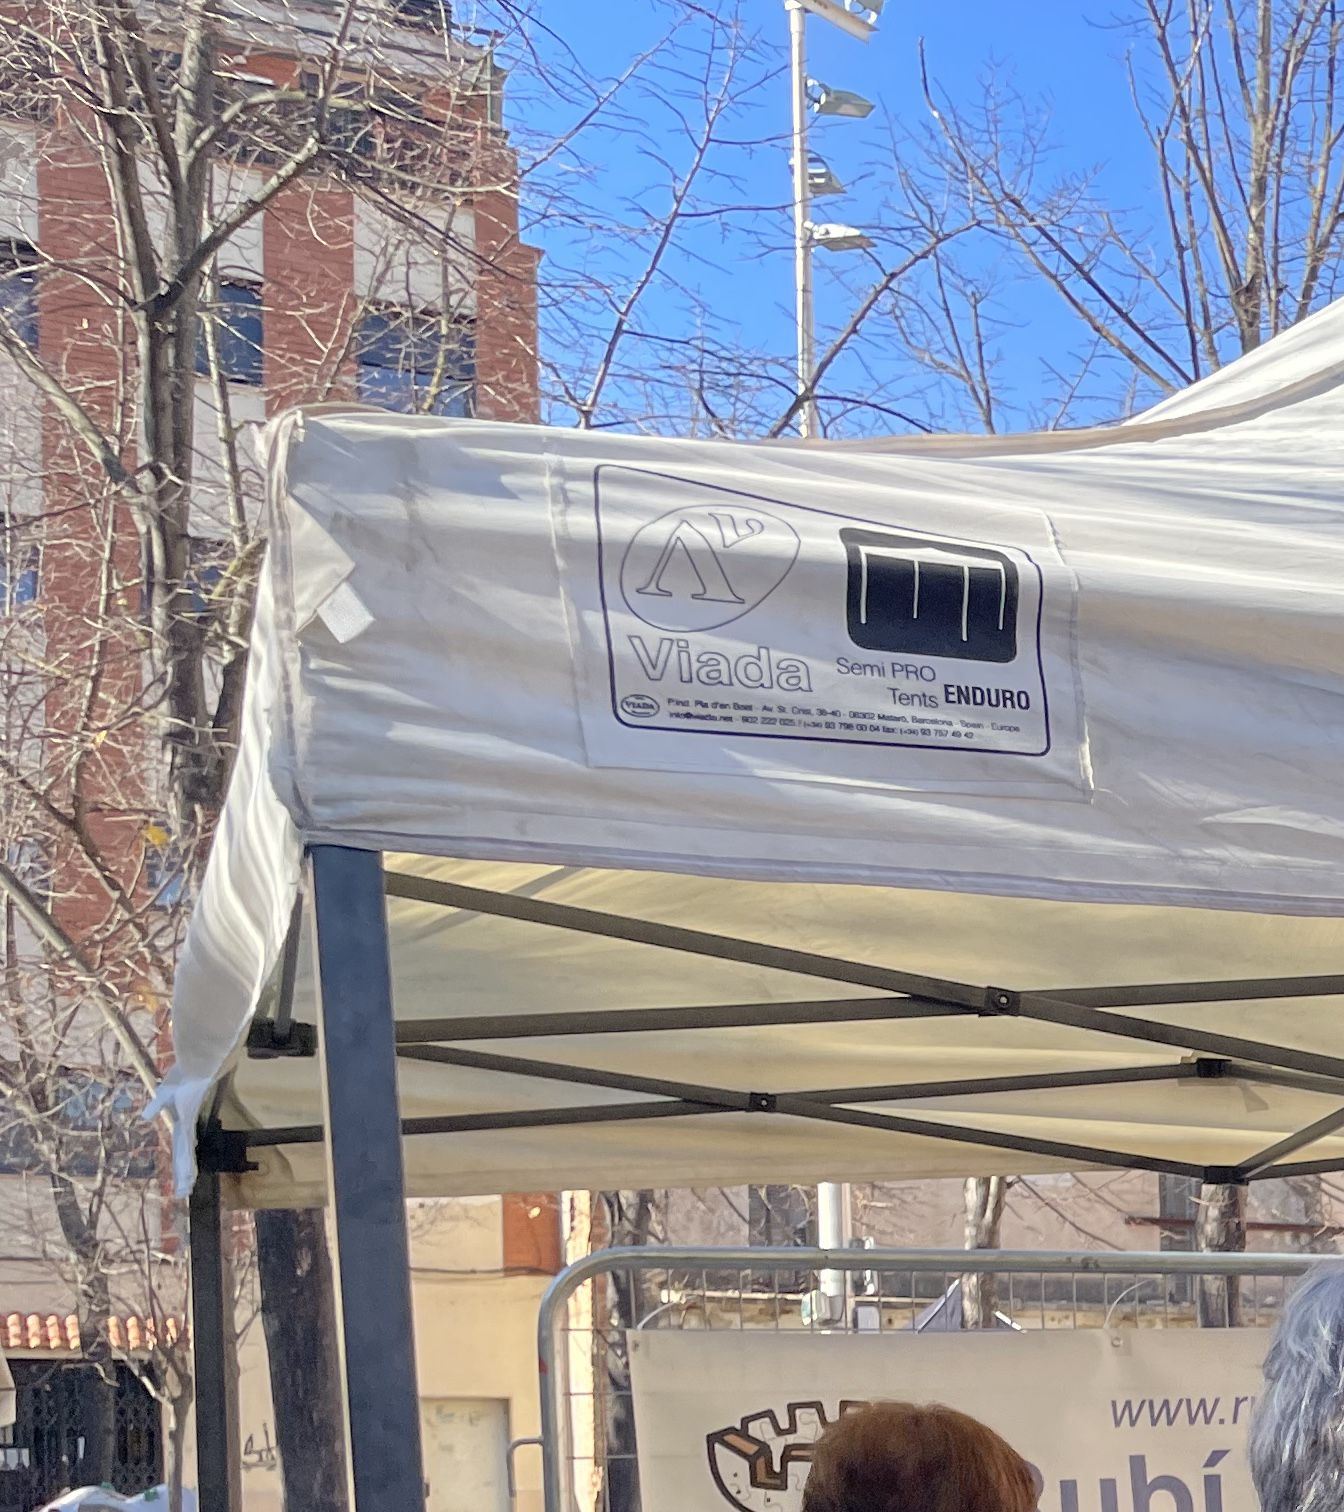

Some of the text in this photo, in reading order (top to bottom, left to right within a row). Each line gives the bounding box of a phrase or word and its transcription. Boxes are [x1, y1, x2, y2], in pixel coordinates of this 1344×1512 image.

[628, 635, 813, 692] Viada
[836, 656, 936, 682] Semi PRO
[887, 684, 1031, 711] Tents ENDURO
